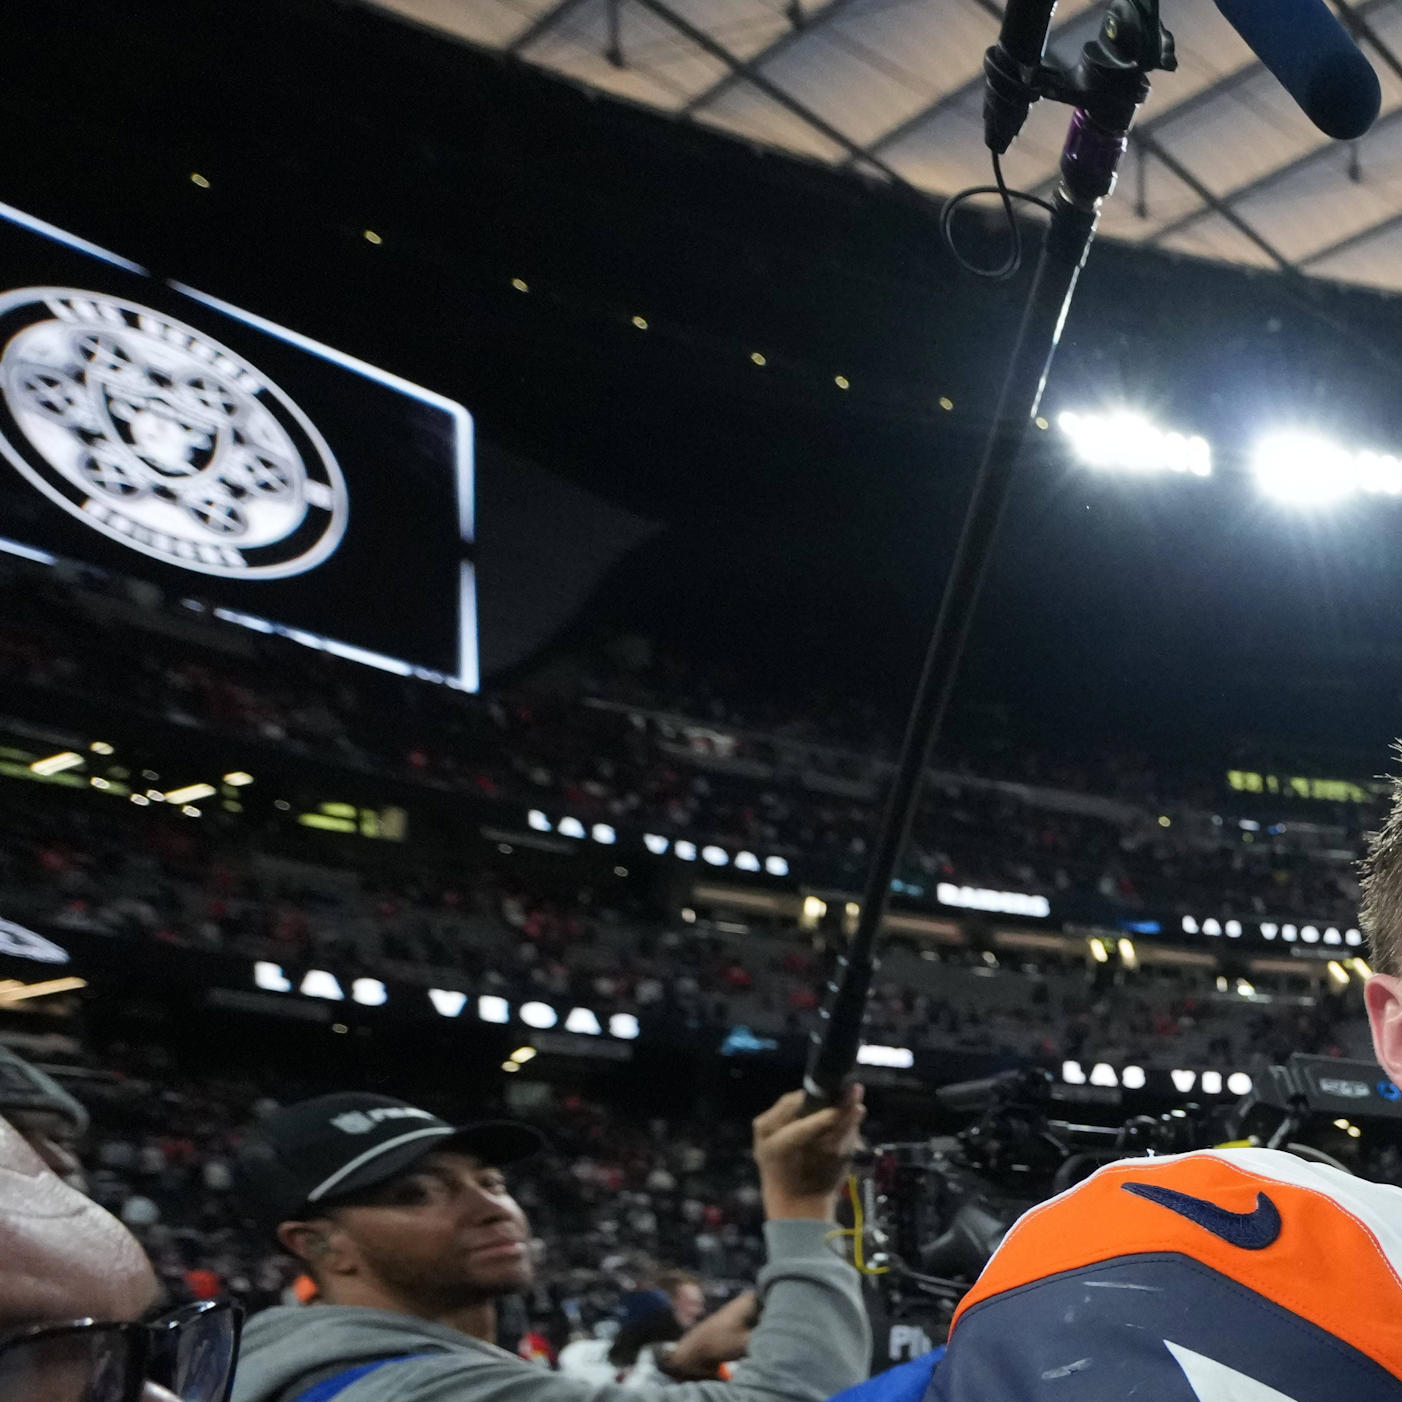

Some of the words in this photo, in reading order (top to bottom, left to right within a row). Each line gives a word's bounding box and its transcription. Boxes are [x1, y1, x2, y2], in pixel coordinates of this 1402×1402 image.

[527, 809, 616, 845] LAS
[643, 833, 788, 876] VEGAS
[1181, 914, 1242, 938] LAS
[254, 960, 388, 1006] LAS
[428, 988, 640, 1039] VEGAS
[1062, 1060, 1146, 1089] LAS
[1170, 1069, 1252, 1095] VEG
